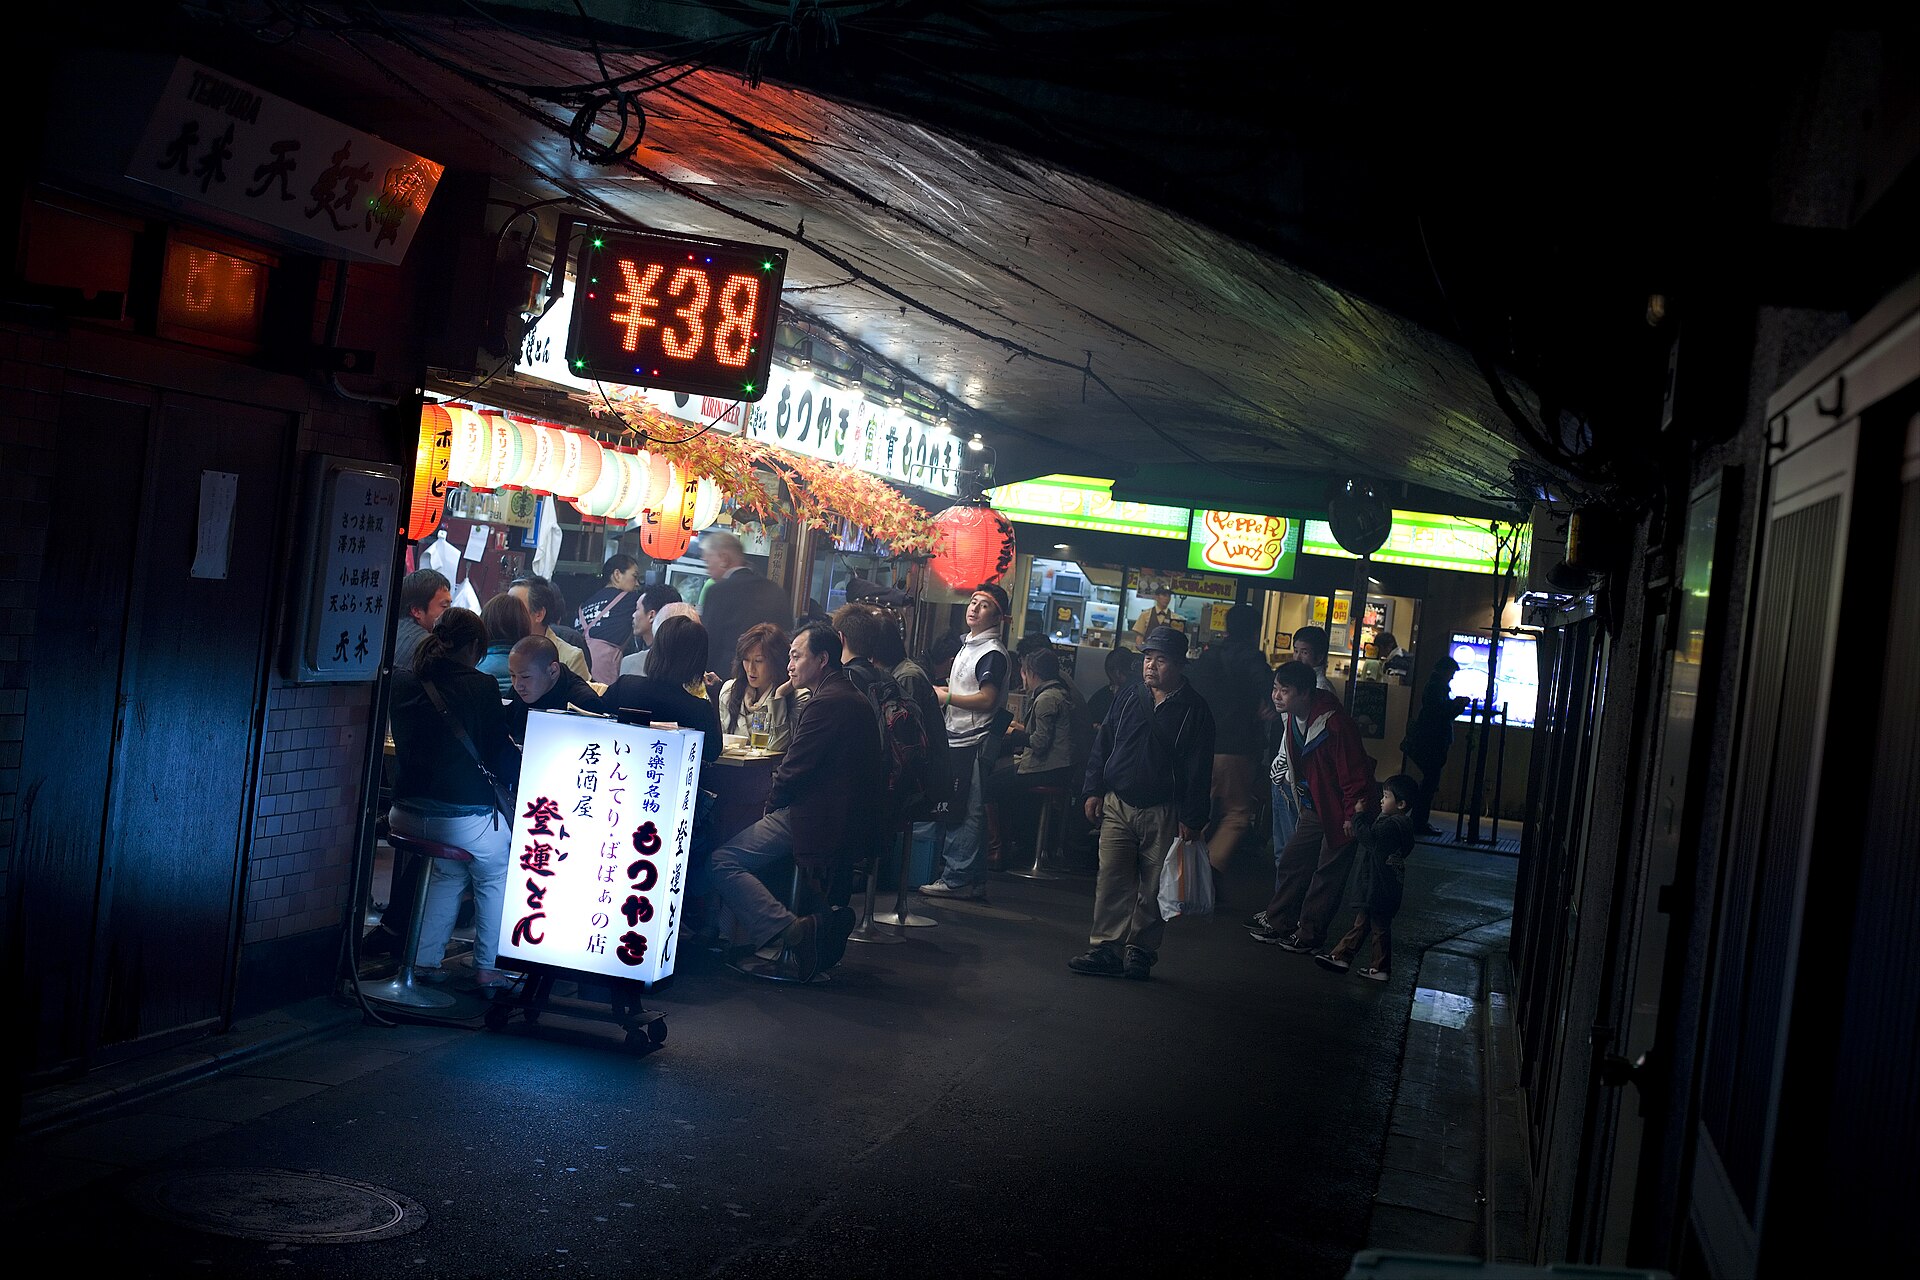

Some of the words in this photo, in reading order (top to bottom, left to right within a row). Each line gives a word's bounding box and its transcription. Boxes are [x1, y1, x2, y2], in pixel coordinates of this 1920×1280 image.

[609, 257, 760, 367] ¥38
[700, 395, 723, 419] KIRIN
[776, 383, 850, 457] もつやき
[902, 426, 952, 487] もつやき
[364, 488, 395, 507] 生ビール
[429, 428, 452, 525] ホッピー
[341, 512, 384, 533] さつま無双
[680, 479, 698, 550] ホッピー
[339, 567, 381, 588] 小品料理
[572, 742, 602, 819] 居酒屋
[642, 739, 668, 813] 有楽町名物
[681, 741, 697, 811] 居酒屋
[511, 796, 564, 948] 登運とん
[616, 820, 662, 967] もつやき
[660, 818, 689, 969] 登運とん
